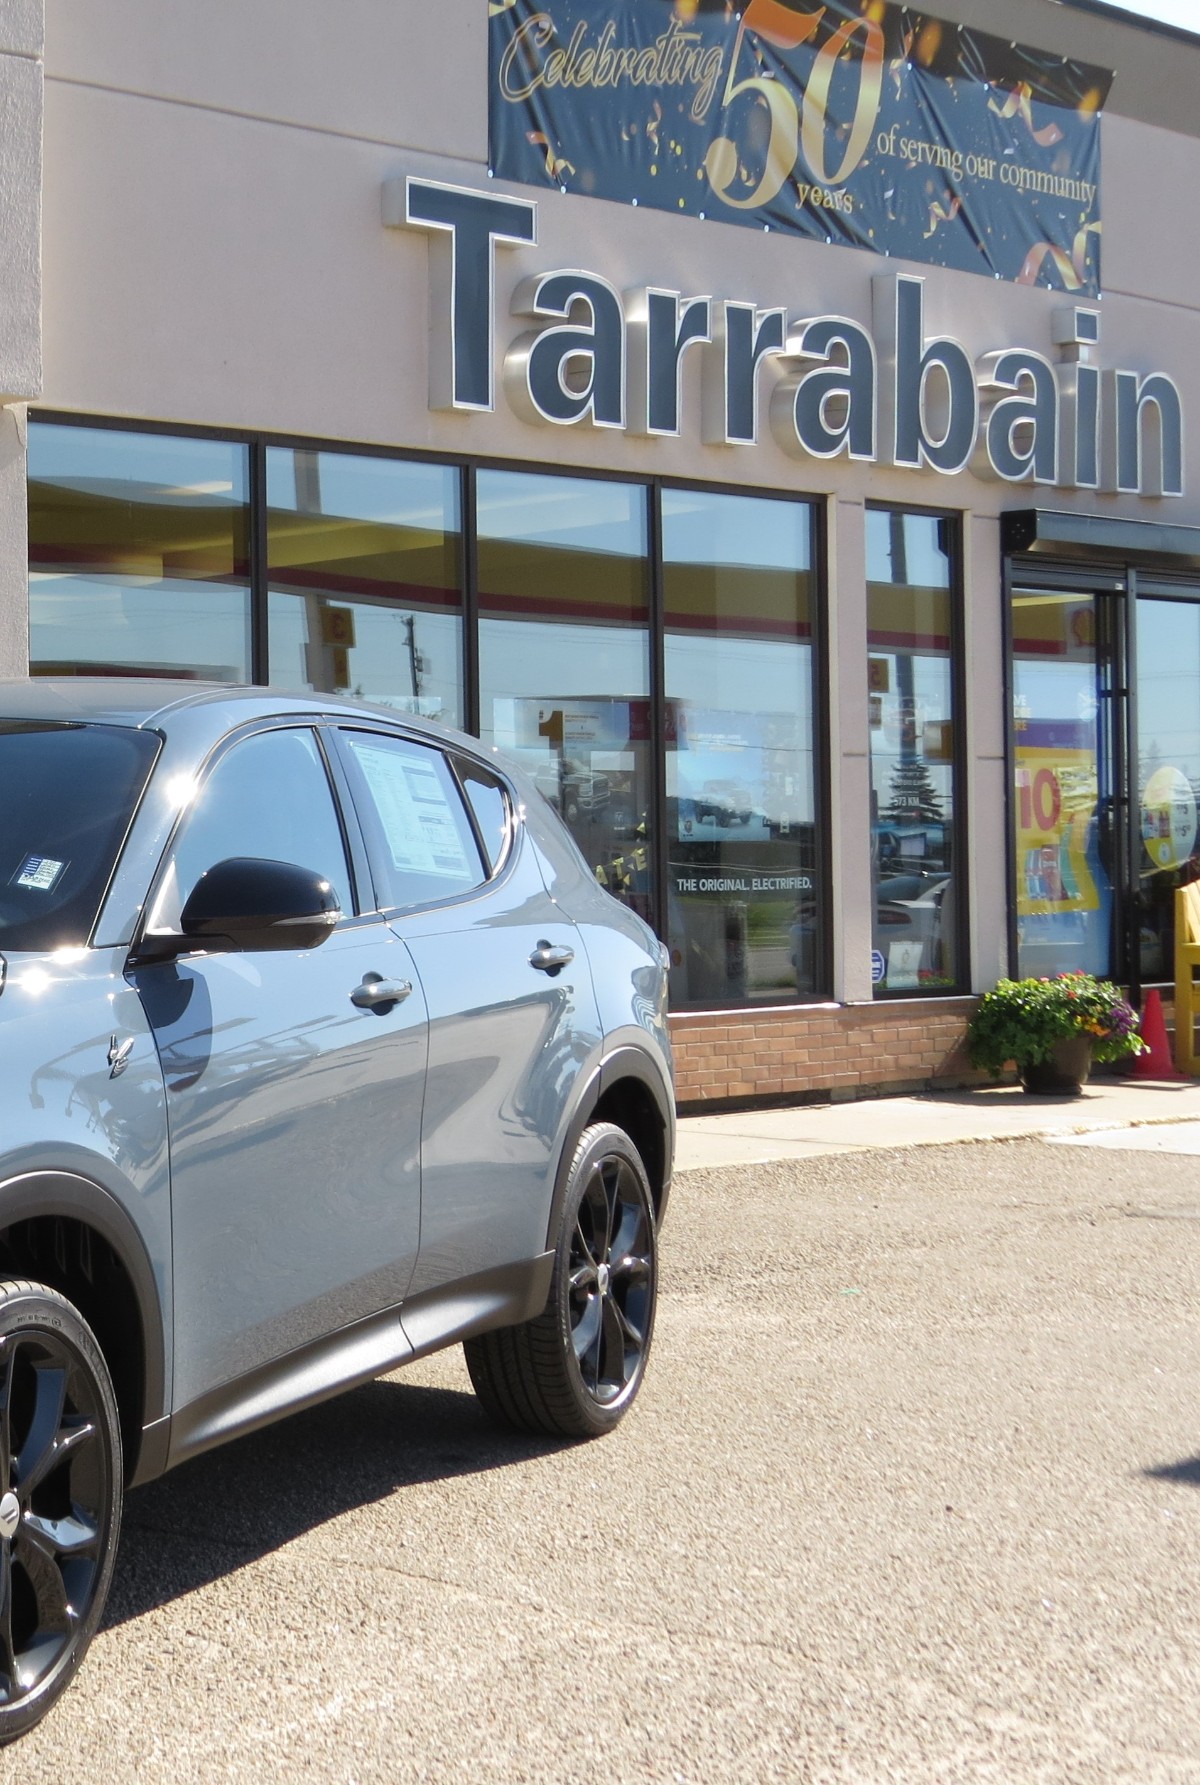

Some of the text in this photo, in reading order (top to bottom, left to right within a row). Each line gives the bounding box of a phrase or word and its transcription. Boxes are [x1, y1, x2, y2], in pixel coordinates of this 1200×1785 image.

[499, 13, 724, 119] Celebrating
[703, 0, 885, 209] 50
[795, 182, 853, 214] years
[877, 123, 1097, 213] of serving our community
[405, 176, 1184, 499] Tarrabain
[677, 877, 812, 891] THE ORIGINAL. ELECTRIFIED.
